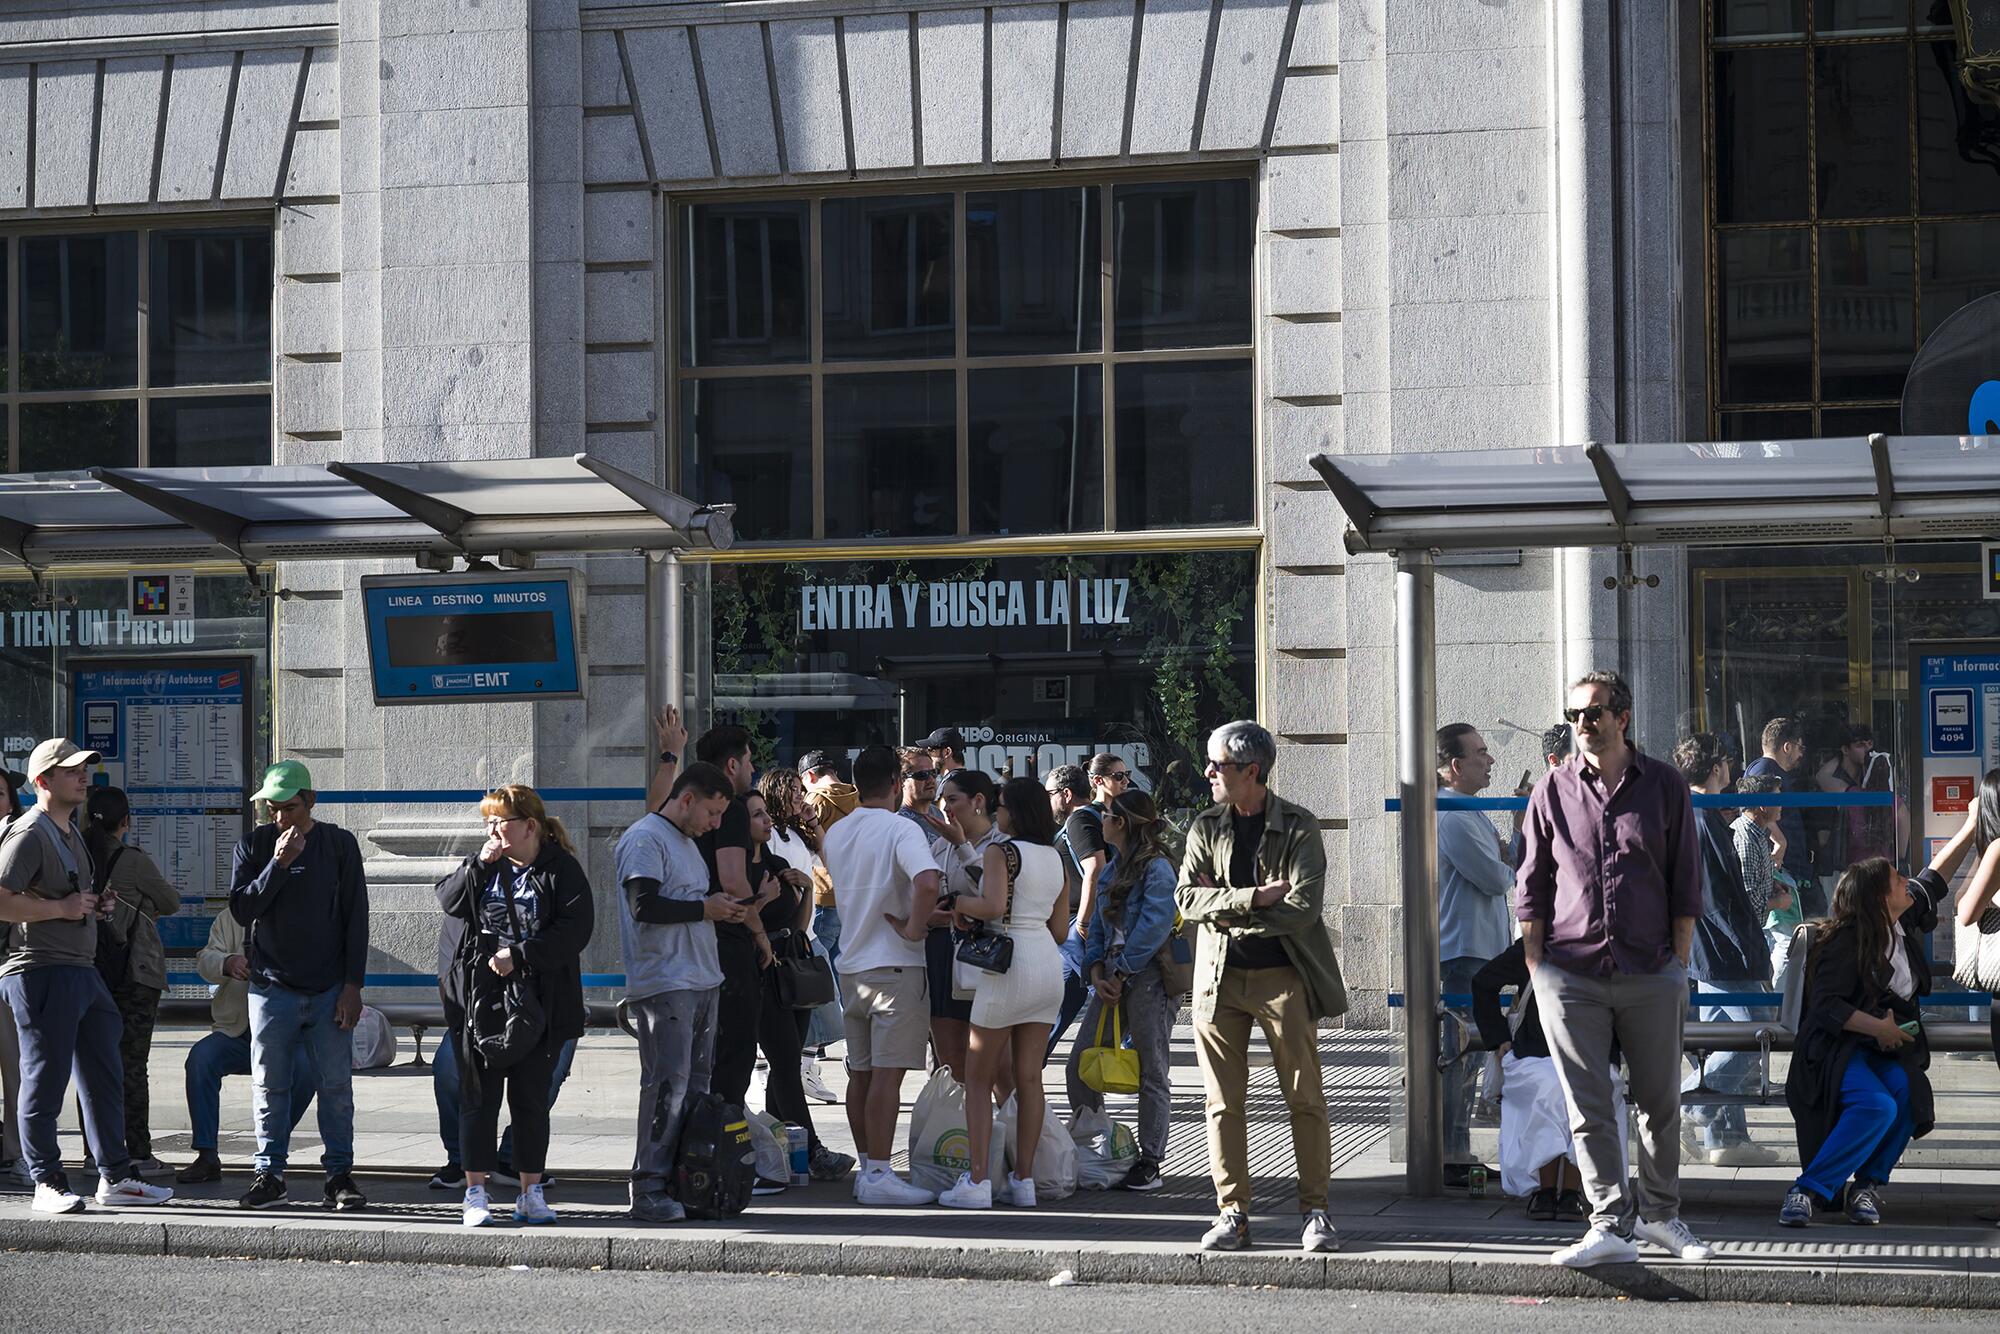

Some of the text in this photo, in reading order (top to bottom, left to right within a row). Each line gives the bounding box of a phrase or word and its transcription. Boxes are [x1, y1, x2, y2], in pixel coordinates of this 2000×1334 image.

[388, 592, 547, 607] LINEA DESTINO MINUTOS
[801, 578, 1131, 631] ENTRA Y BUSCA LA LUZ
[11, 610, 71, 647] TIENE
[77, 609, 109, 647] UN
[116, 609, 195, 645] PRECIO
[1953, 660, 2000, 672] Informac
[155, 673, 167, 686] de
[168, 673, 213, 686] Autobuses
[473, 671, 510, 687] EMT
[957, 726, 1052, 743] HBO ORIGINAL
[1939, 732, 1965, 742] 4094
[3, 736, 36, 753] HBO
